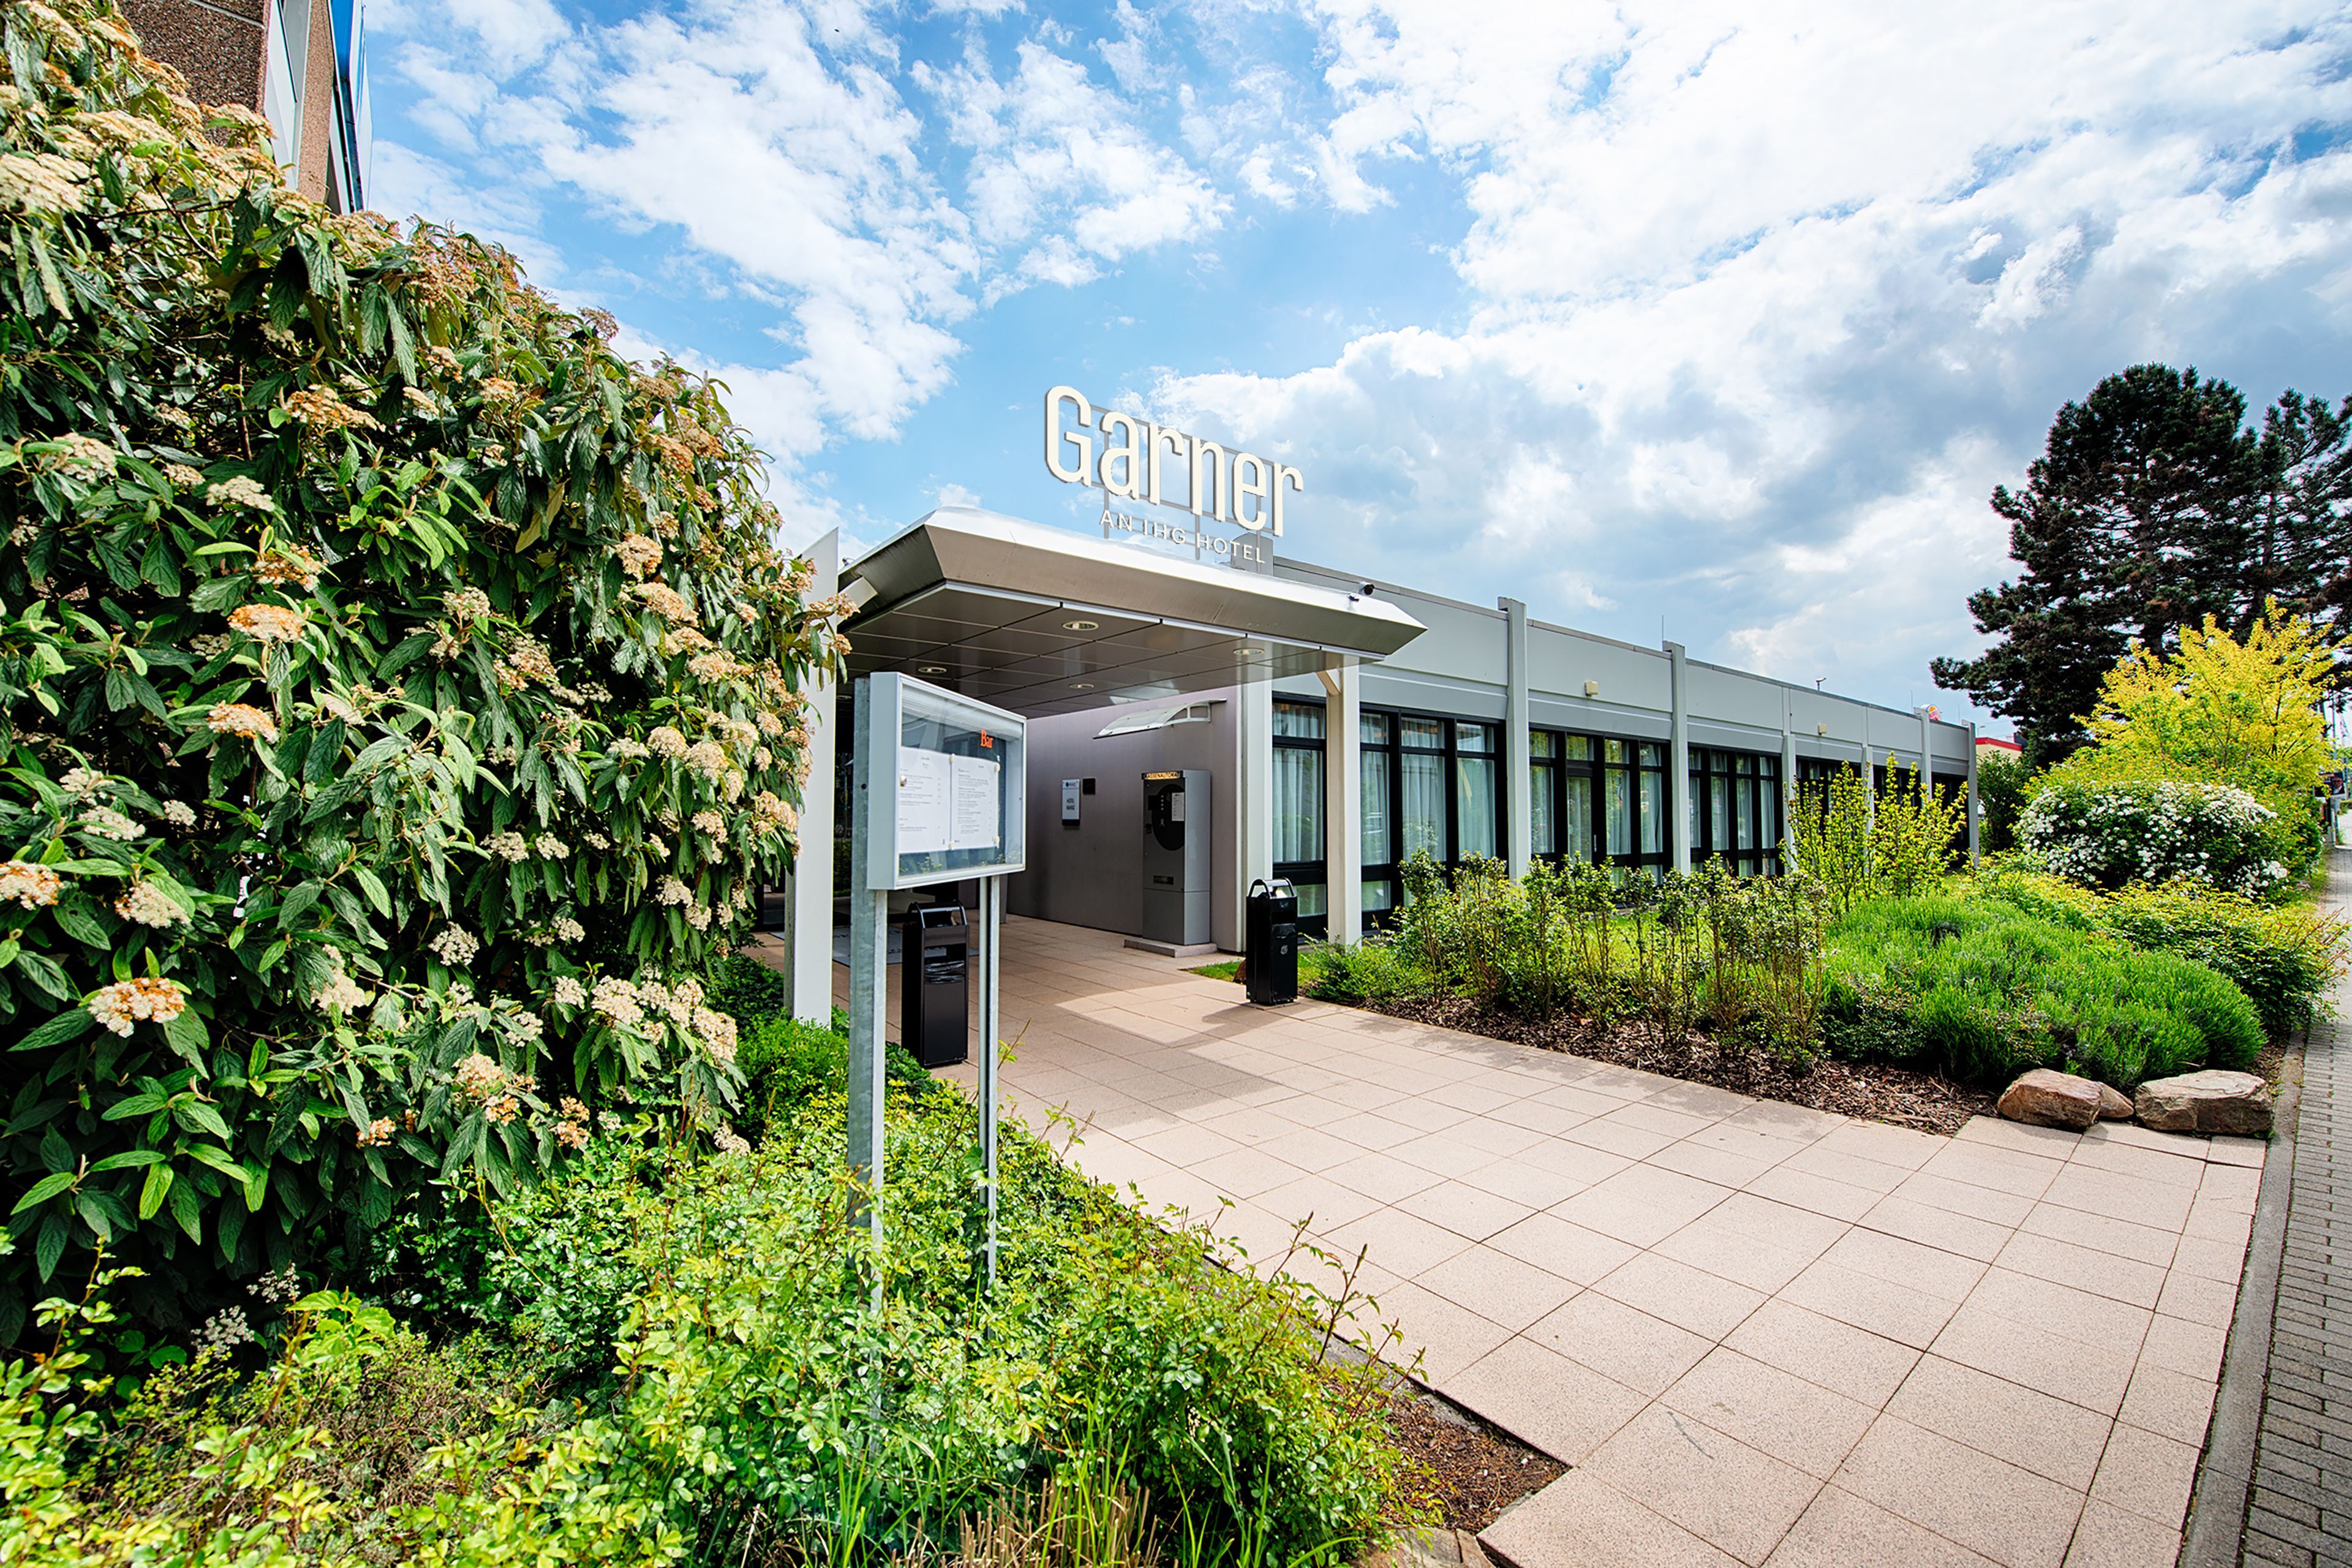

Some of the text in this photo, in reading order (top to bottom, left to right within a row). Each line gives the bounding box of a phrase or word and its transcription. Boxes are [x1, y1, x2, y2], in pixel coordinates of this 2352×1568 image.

[1045, 385, 1304, 537] Garner
[1099, 510, 1265, 564] AN IHG HOTEL
[981, 729, 993, 748] Bar
